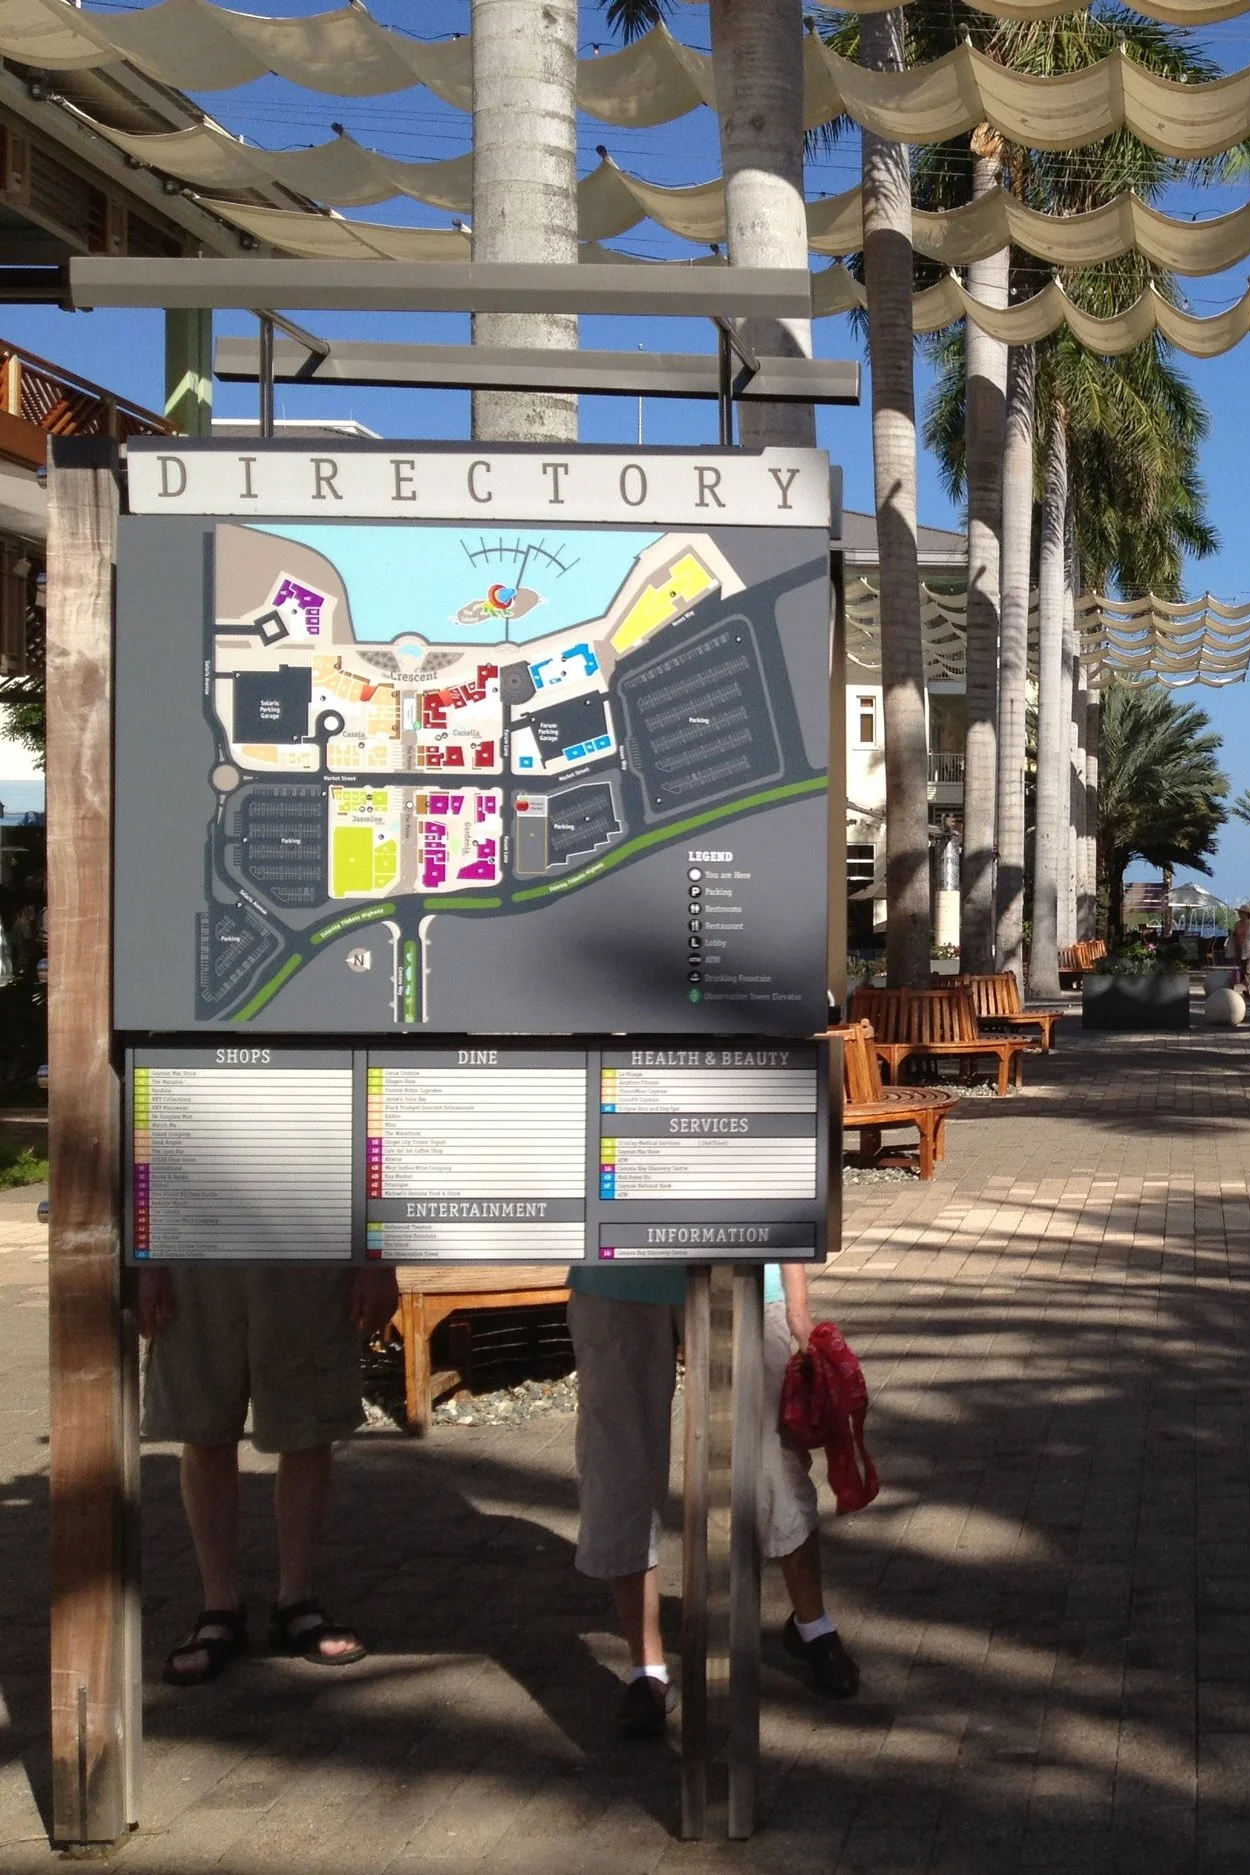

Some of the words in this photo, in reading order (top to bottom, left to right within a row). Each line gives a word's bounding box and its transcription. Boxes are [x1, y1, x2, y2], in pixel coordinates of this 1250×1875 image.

[157, 456, 802, 510] DIRECTORY
[391, 668, 437, 682] Crescent
[538, 729, 558, 737] Parking
[688, 851, 733, 862] LEGEND
[705, 871, 718, 879] You
[720, 871, 732, 879] are
[733, 871, 751, 879] Here
[705, 888, 733, 898] Parking
[705, 905, 743, 913] Restrooms
[705, 922, 744, 930] Restaurant
[705, 938, 727, 947] Lobby
[353, 954, 364, 966] N
[216, 1049, 271, 1064] SHOPS
[457, 1051, 498, 1064] DINE
[631, 1051, 699, 1066] HEALTH
[704, 1051, 716, 1066] &
[721, 1051, 789, 1066] BEAUTY
[669, 1118, 749, 1133] SERVICES
[406, 1202, 547, 1217] ENTERTAINMENT
[647, 1227, 769, 1242] INFORMATION
